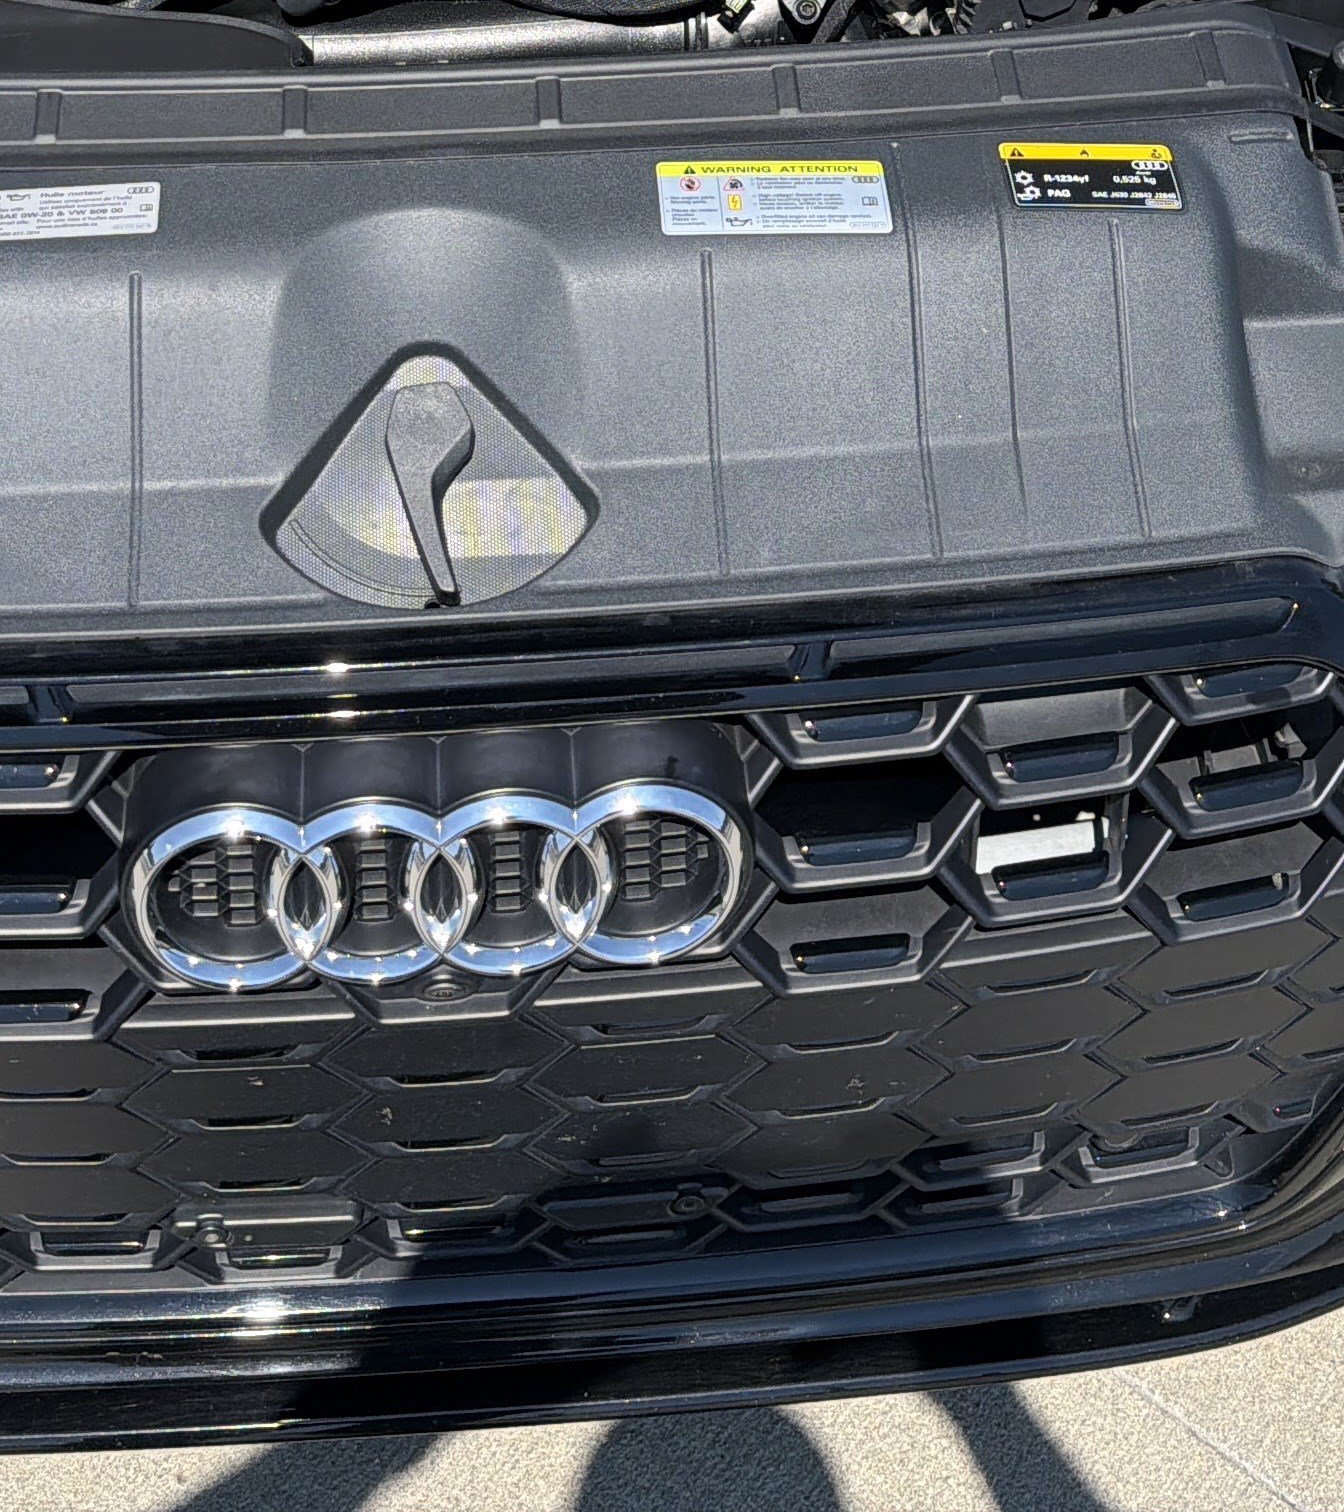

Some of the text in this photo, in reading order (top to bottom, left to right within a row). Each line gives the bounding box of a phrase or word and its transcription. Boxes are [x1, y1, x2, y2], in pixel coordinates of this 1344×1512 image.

[702, 165, 858, 173] WARNING ATTENTION
[1043, 175, 1089, 184] R-1234yf
[1143, 176, 1156, 185] kg
[1047, 189, 1071, 197] PAG
